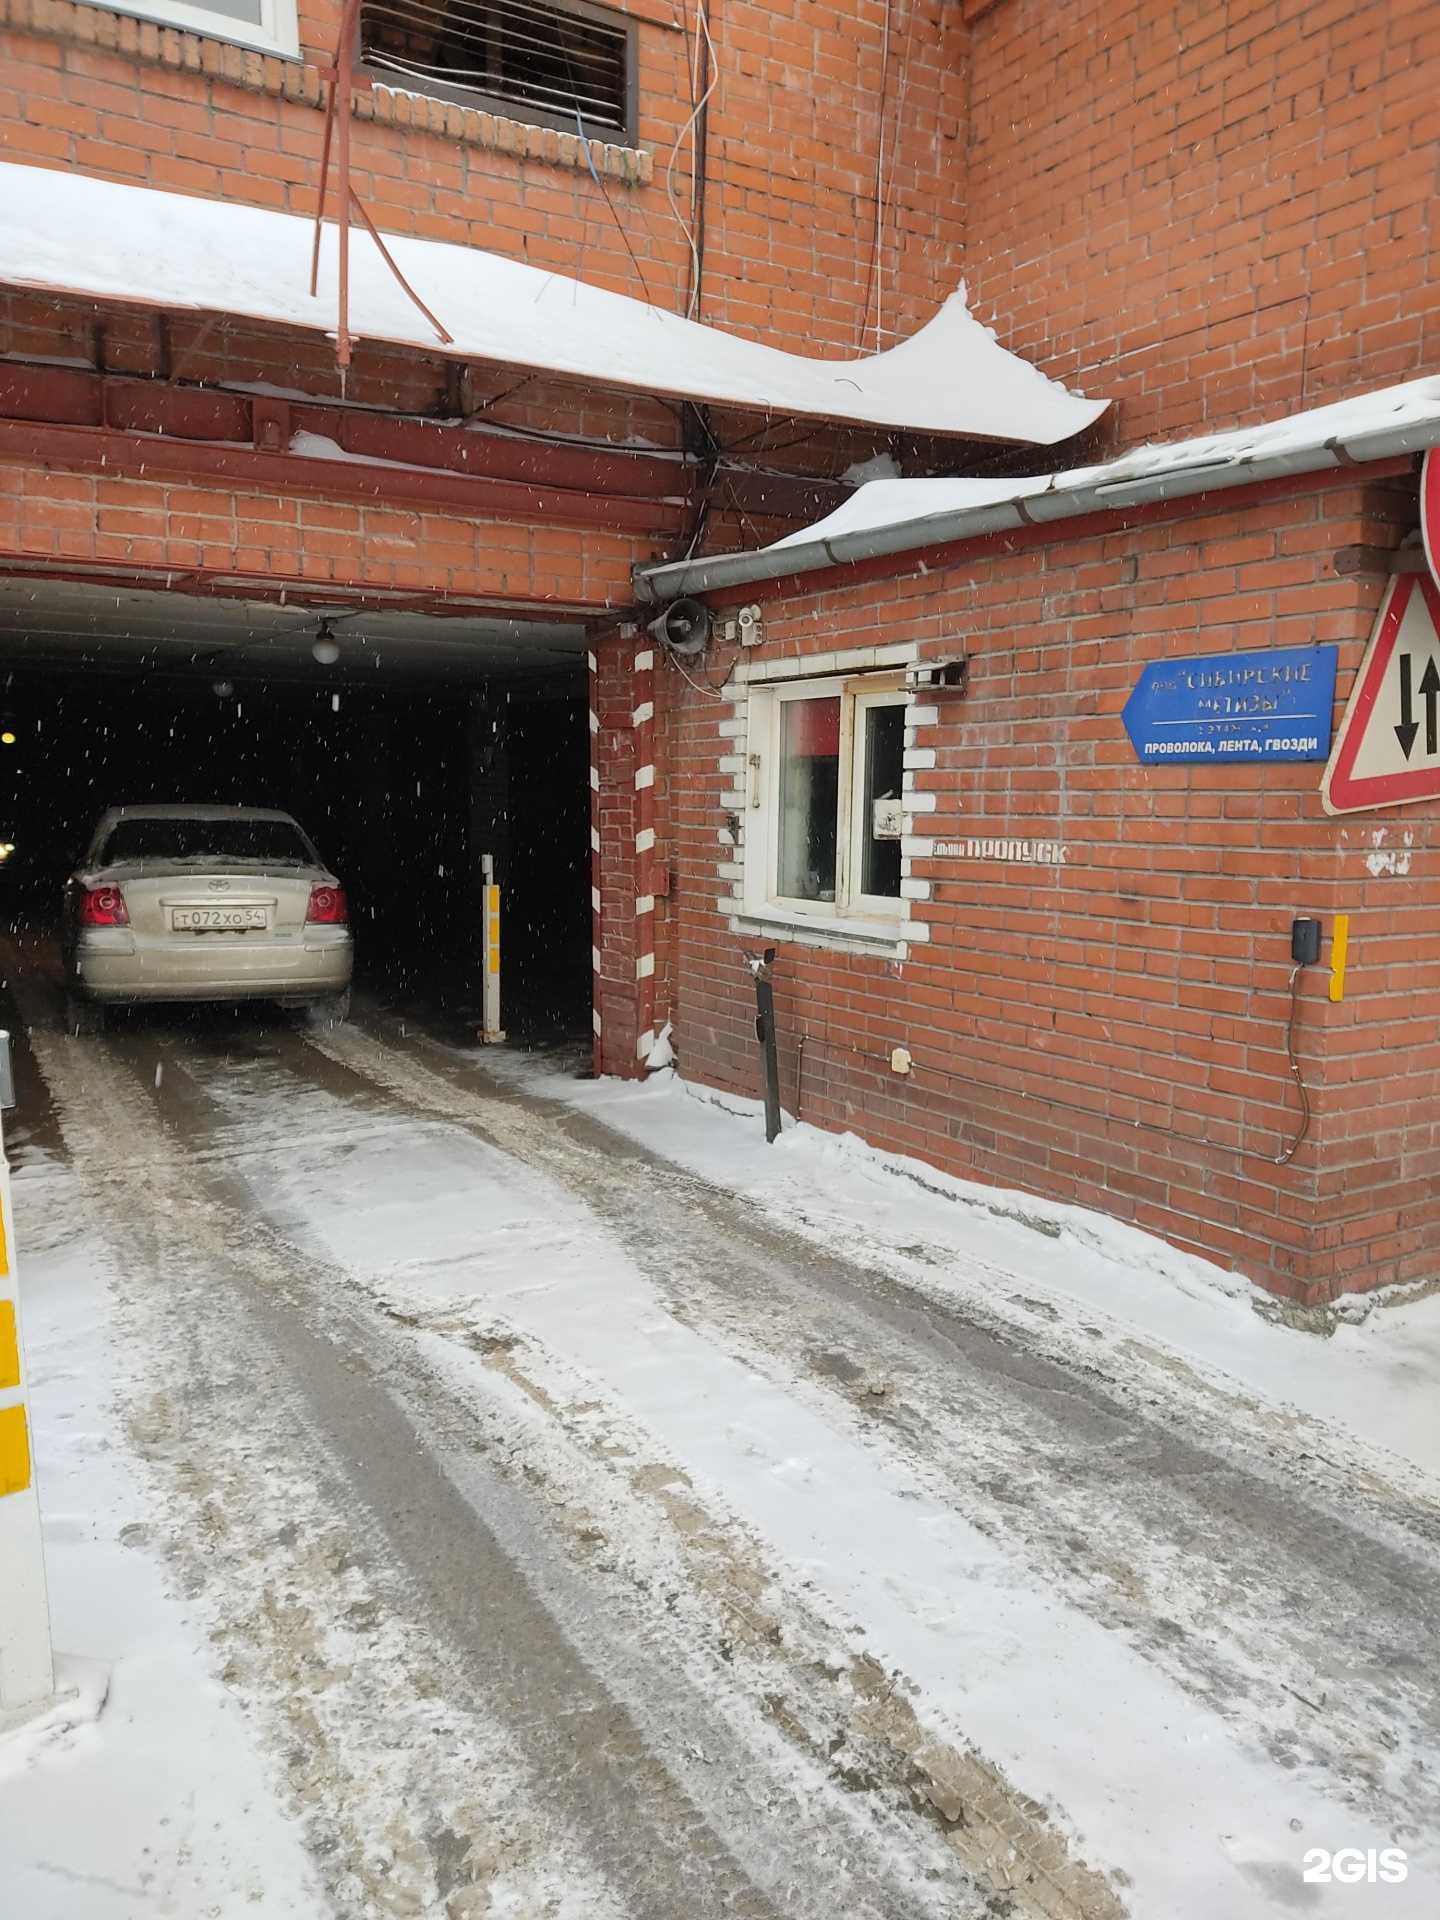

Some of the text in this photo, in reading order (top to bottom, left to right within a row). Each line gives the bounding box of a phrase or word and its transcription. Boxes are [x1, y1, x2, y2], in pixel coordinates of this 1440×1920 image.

[1144, 737, 1318, 755] ПРОВОЛОКА, ЛЕНТА, ГВОЗДИ
